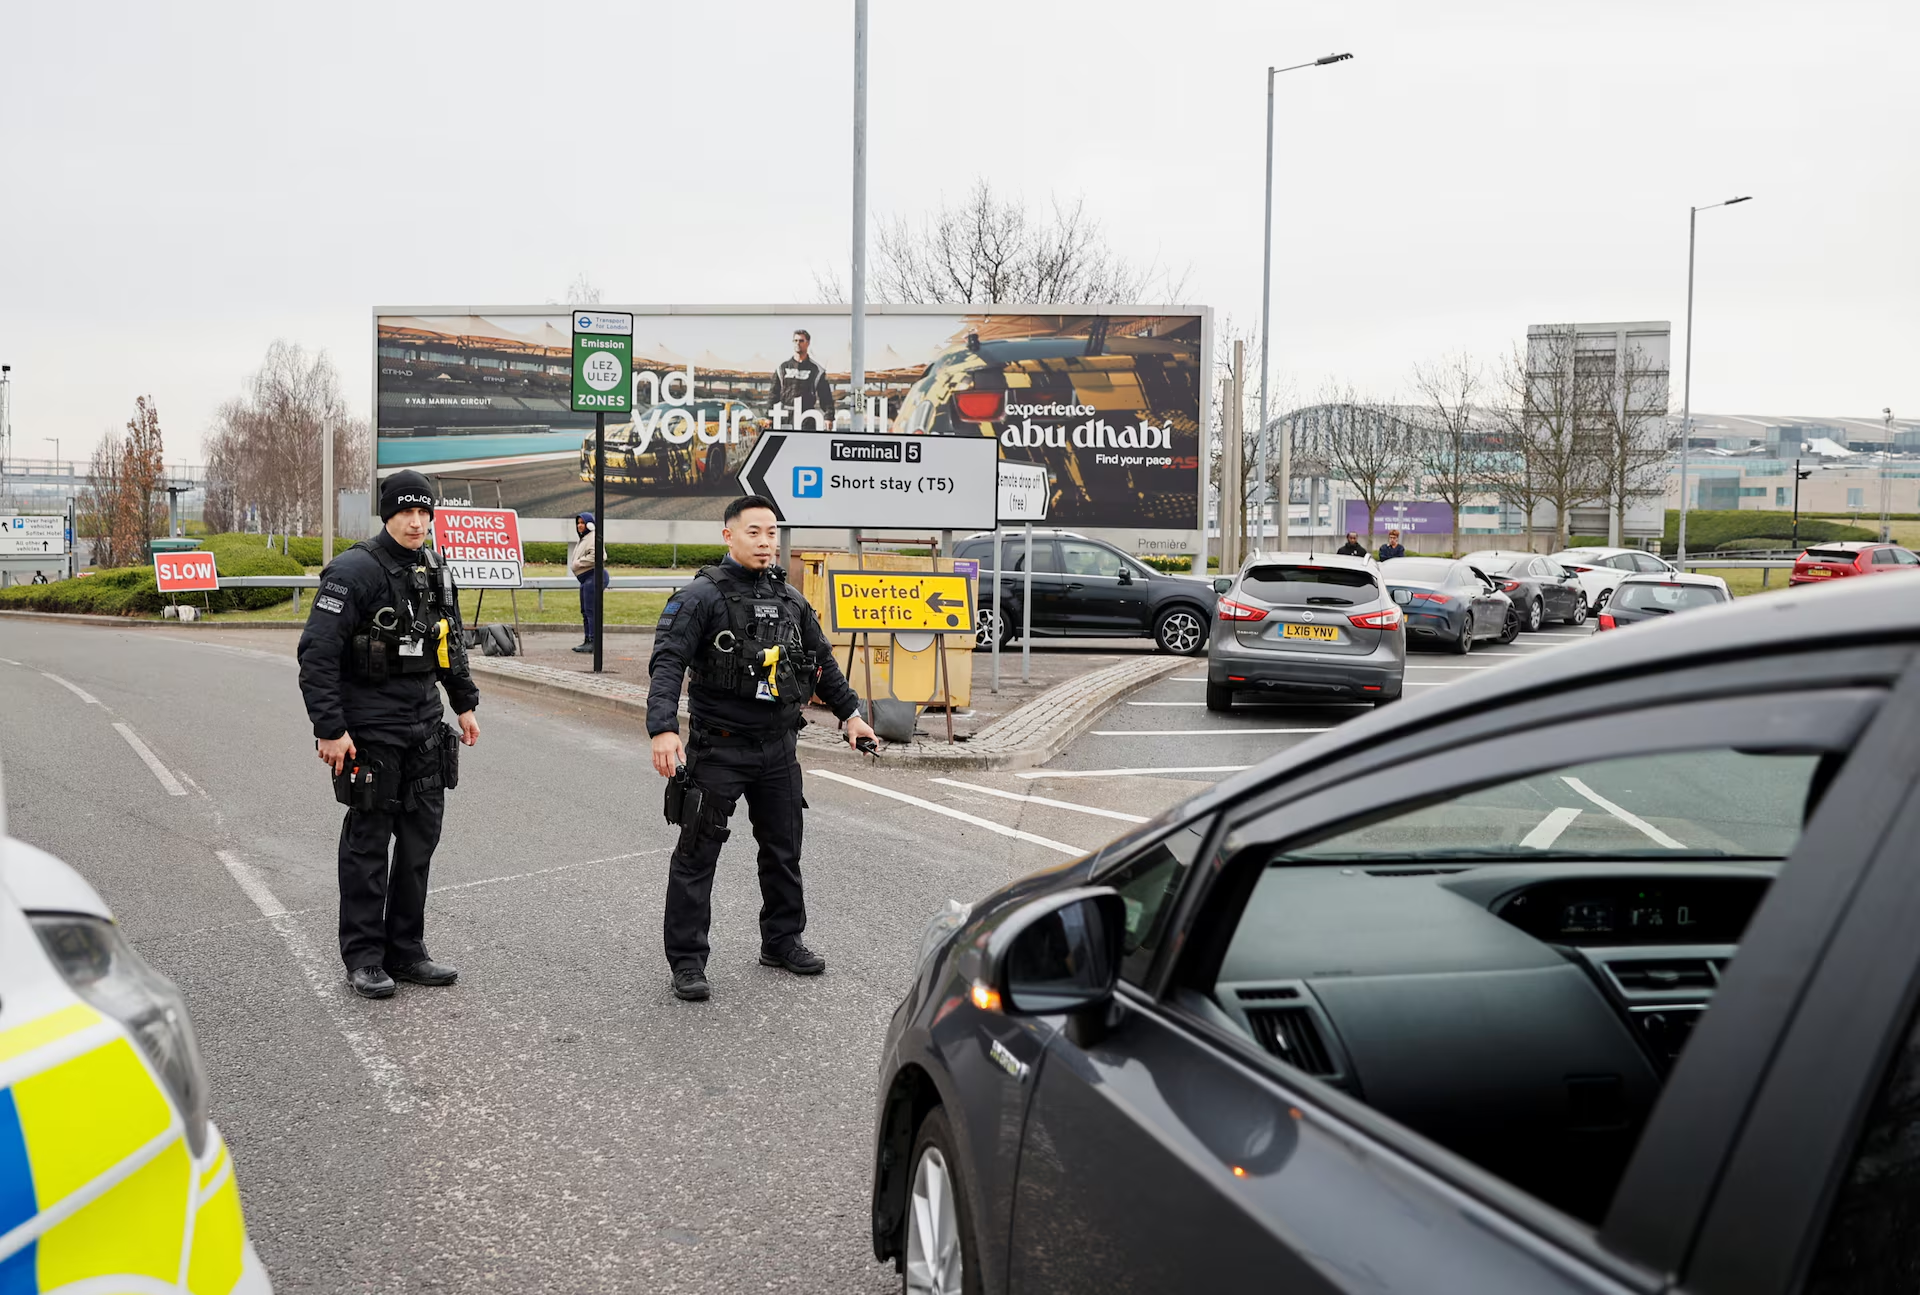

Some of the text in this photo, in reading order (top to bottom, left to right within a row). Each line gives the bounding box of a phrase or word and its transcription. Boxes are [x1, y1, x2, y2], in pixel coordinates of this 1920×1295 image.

[581, 338, 625, 349] Emission
[592, 361, 613, 370] LEZ
[588, 372, 617, 381] ULEZ
[632, 362, 695, 406] nd
[578, 394, 625, 406] ZONES
[630, 408, 752, 456] your
[768, 396, 889, 432] thrll
[1001, 418, 1067, 448] abu
[833, 443, 918, 460] Terminal 5
[1095, 453, 1172, 467] Find your pace
[798, 470, 818, 495] P
[830, 476, 954, 494] Short stay (T5)
[999, 472, 1017, 487] emote
[1019, 472, 1031, 491] drop
[397, 494, 431, 505] POLICE
[1009, 493, 1027, 512] (free)
[445, 515, 506, 530] WORKS
[445, 530, 510, 545] TRAFFIC
[1138, 538, 1187, 550] Première
[441, 546, 518, 560] MERGING
[160, 563, 211, 580] SLOW
[451, 566, 513, 580] AHEAD
[841, 584, 920, 599] Diverted
[853, 605, 913, 620] traffic
[1287, 625, 1334, 638] LX16 YNV
